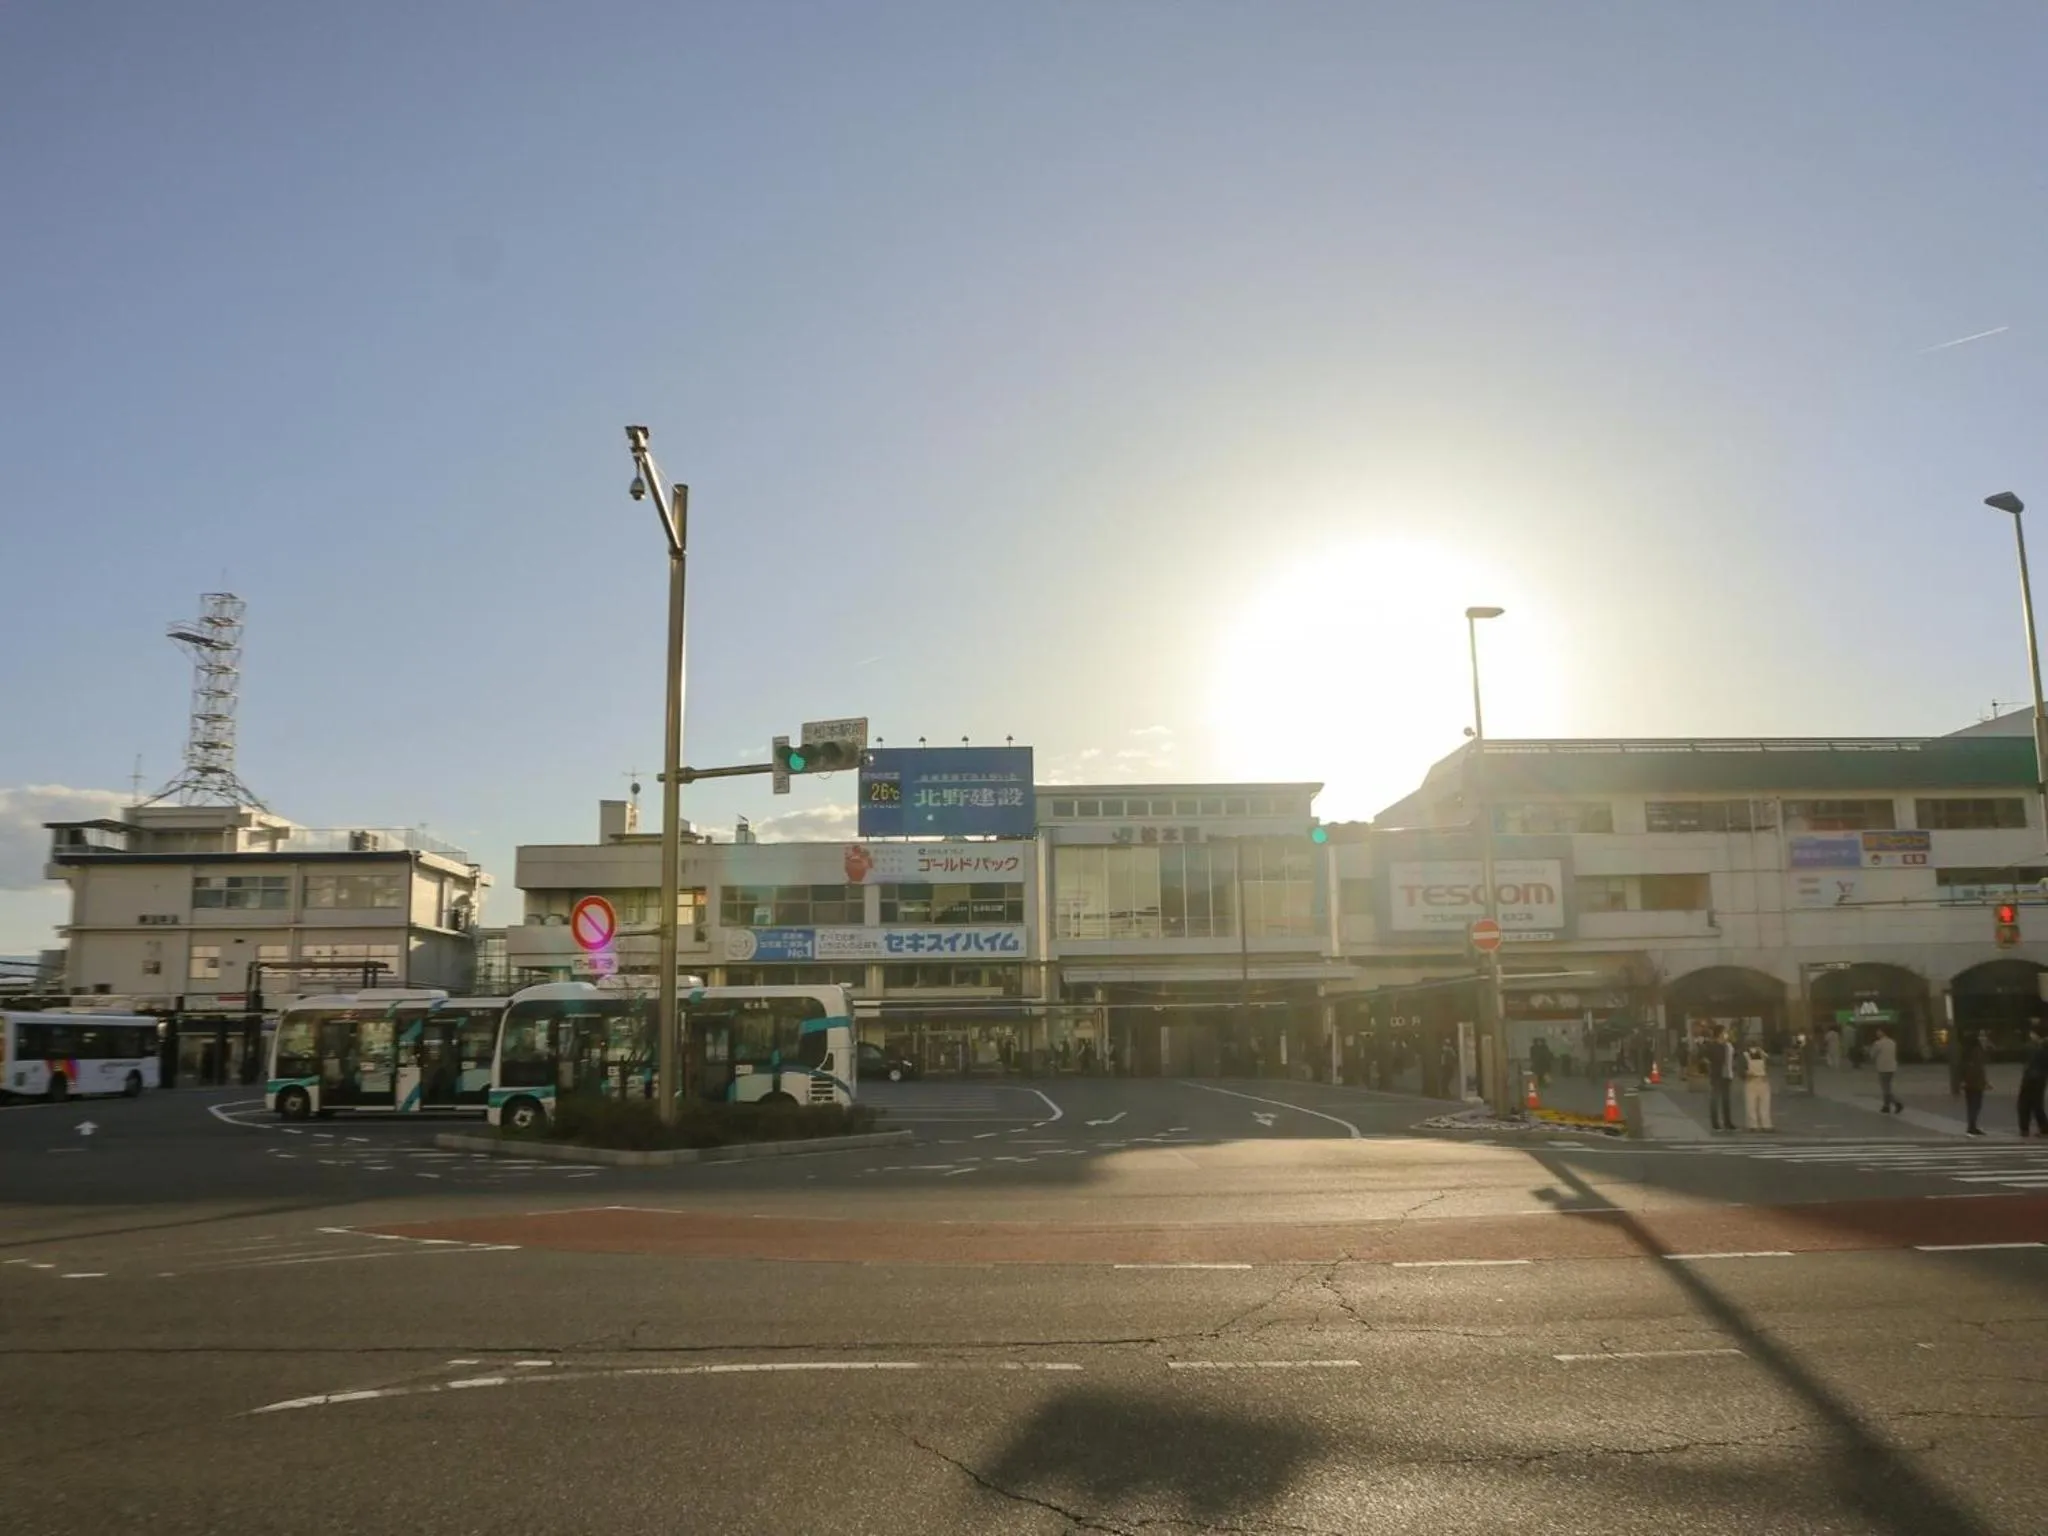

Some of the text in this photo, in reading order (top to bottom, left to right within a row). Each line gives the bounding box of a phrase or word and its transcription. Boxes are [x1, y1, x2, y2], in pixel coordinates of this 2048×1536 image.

[914, 786, 1025, 808] 北野建設
[1398, 882, 1555, 907] TESCOM
[884, 931, 1020, 953] セキスイハイム
